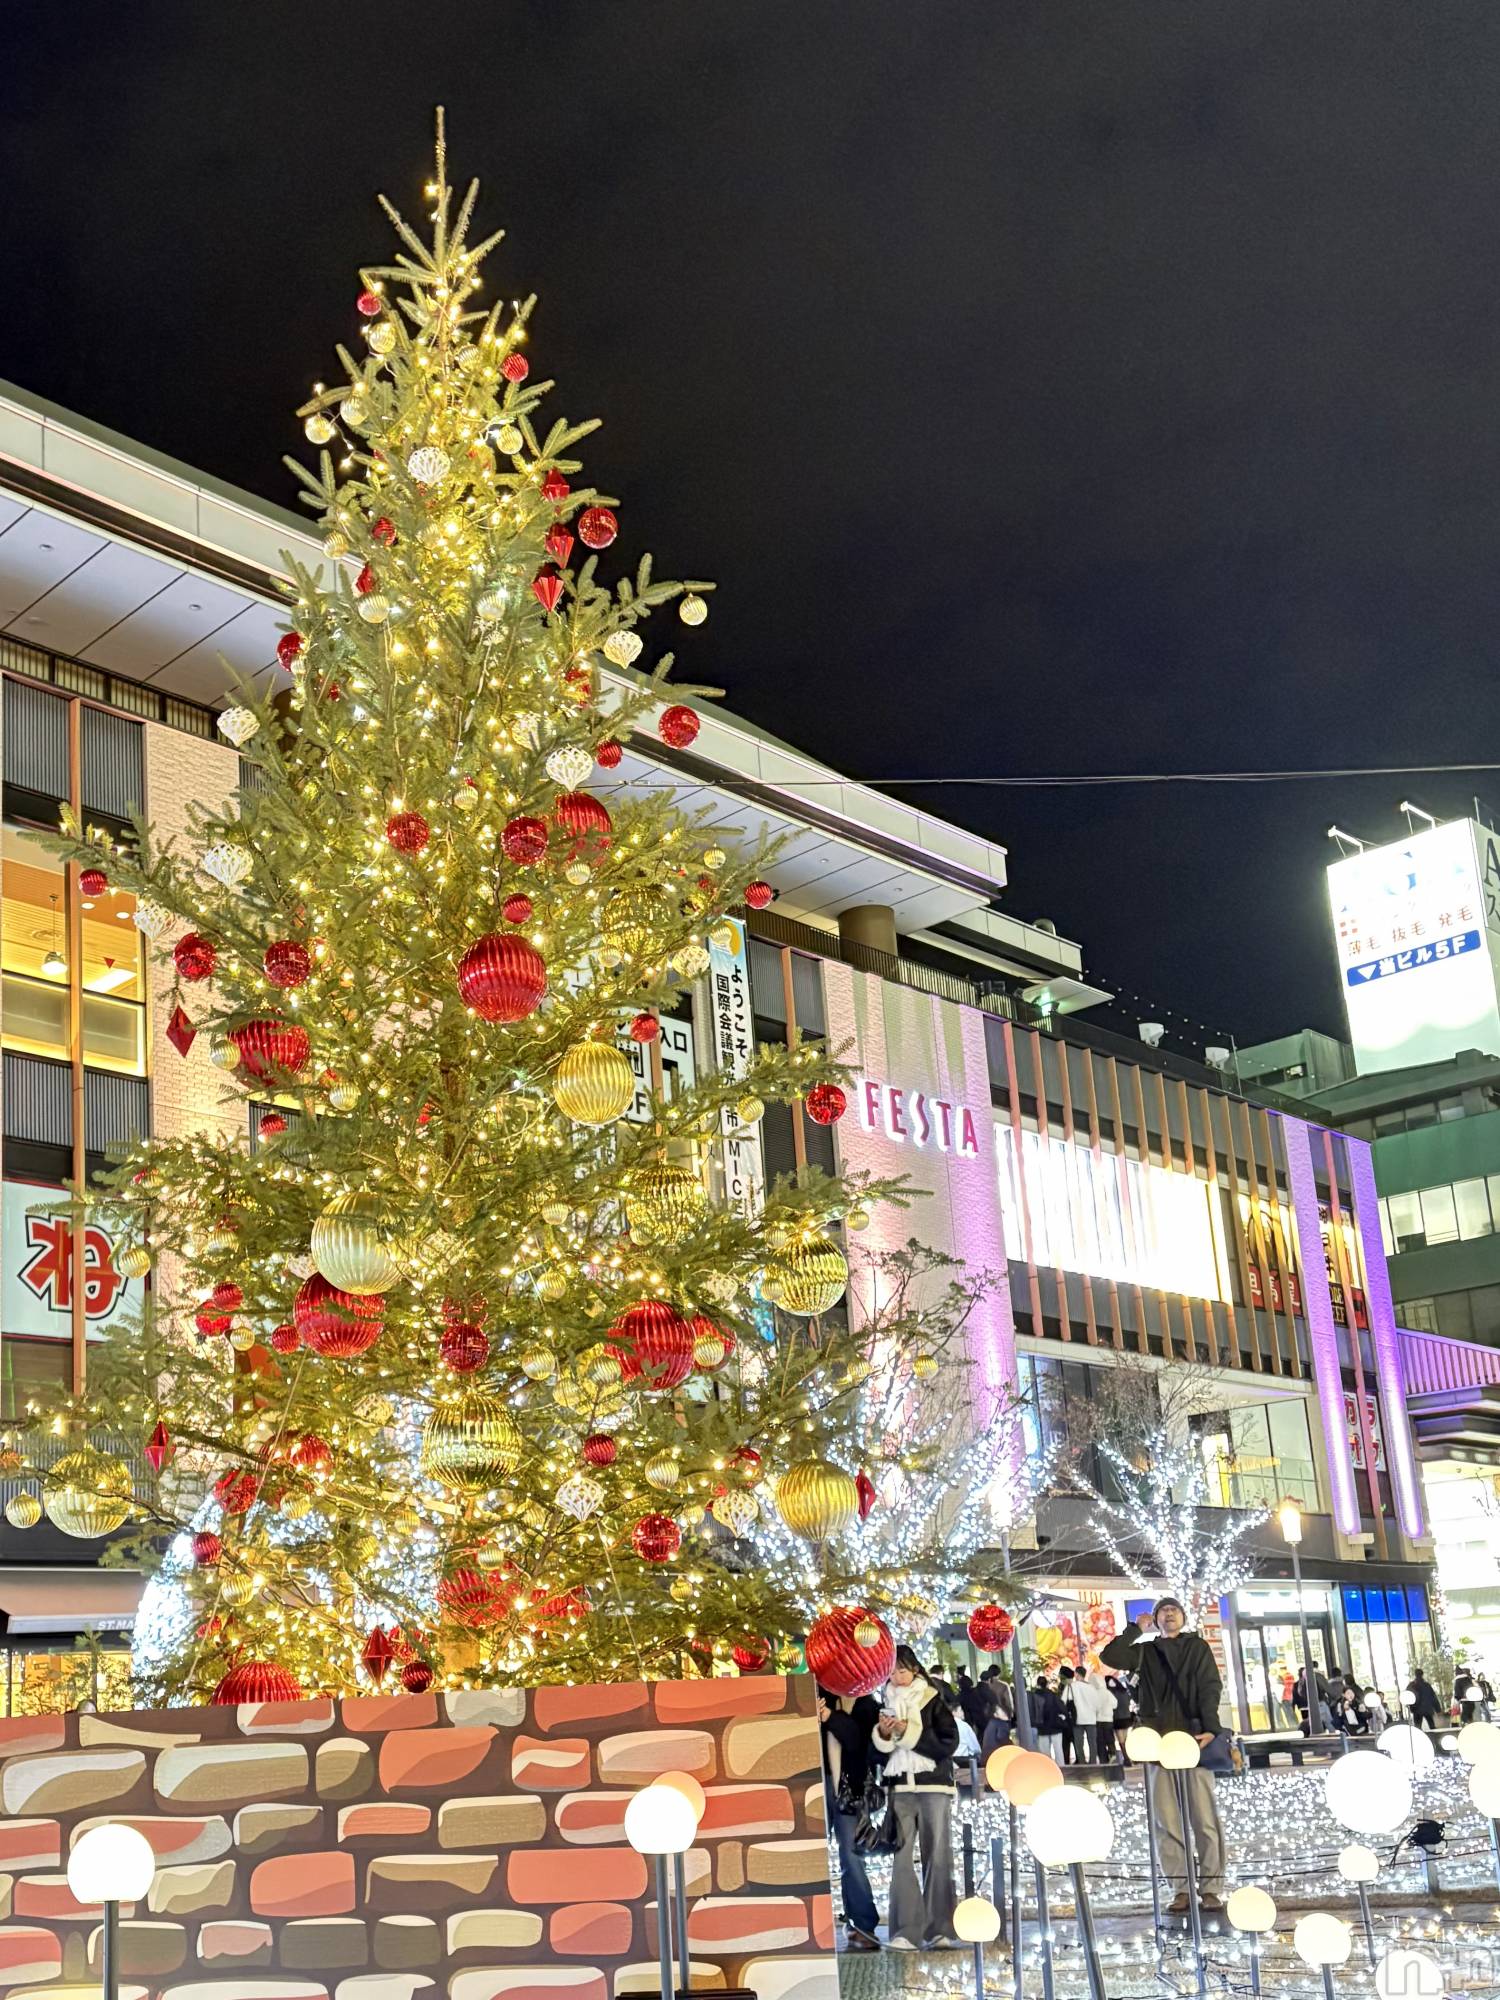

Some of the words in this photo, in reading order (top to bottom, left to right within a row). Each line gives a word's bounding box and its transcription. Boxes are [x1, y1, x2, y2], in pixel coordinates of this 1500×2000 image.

[716, 973, 738, 1128] 国際会議観光市
[731, 963, 748, 1059] ようこそ
[863, 1080, 980, 1154] FESTA
[97, 1620, 135, 1631] ST.MA
